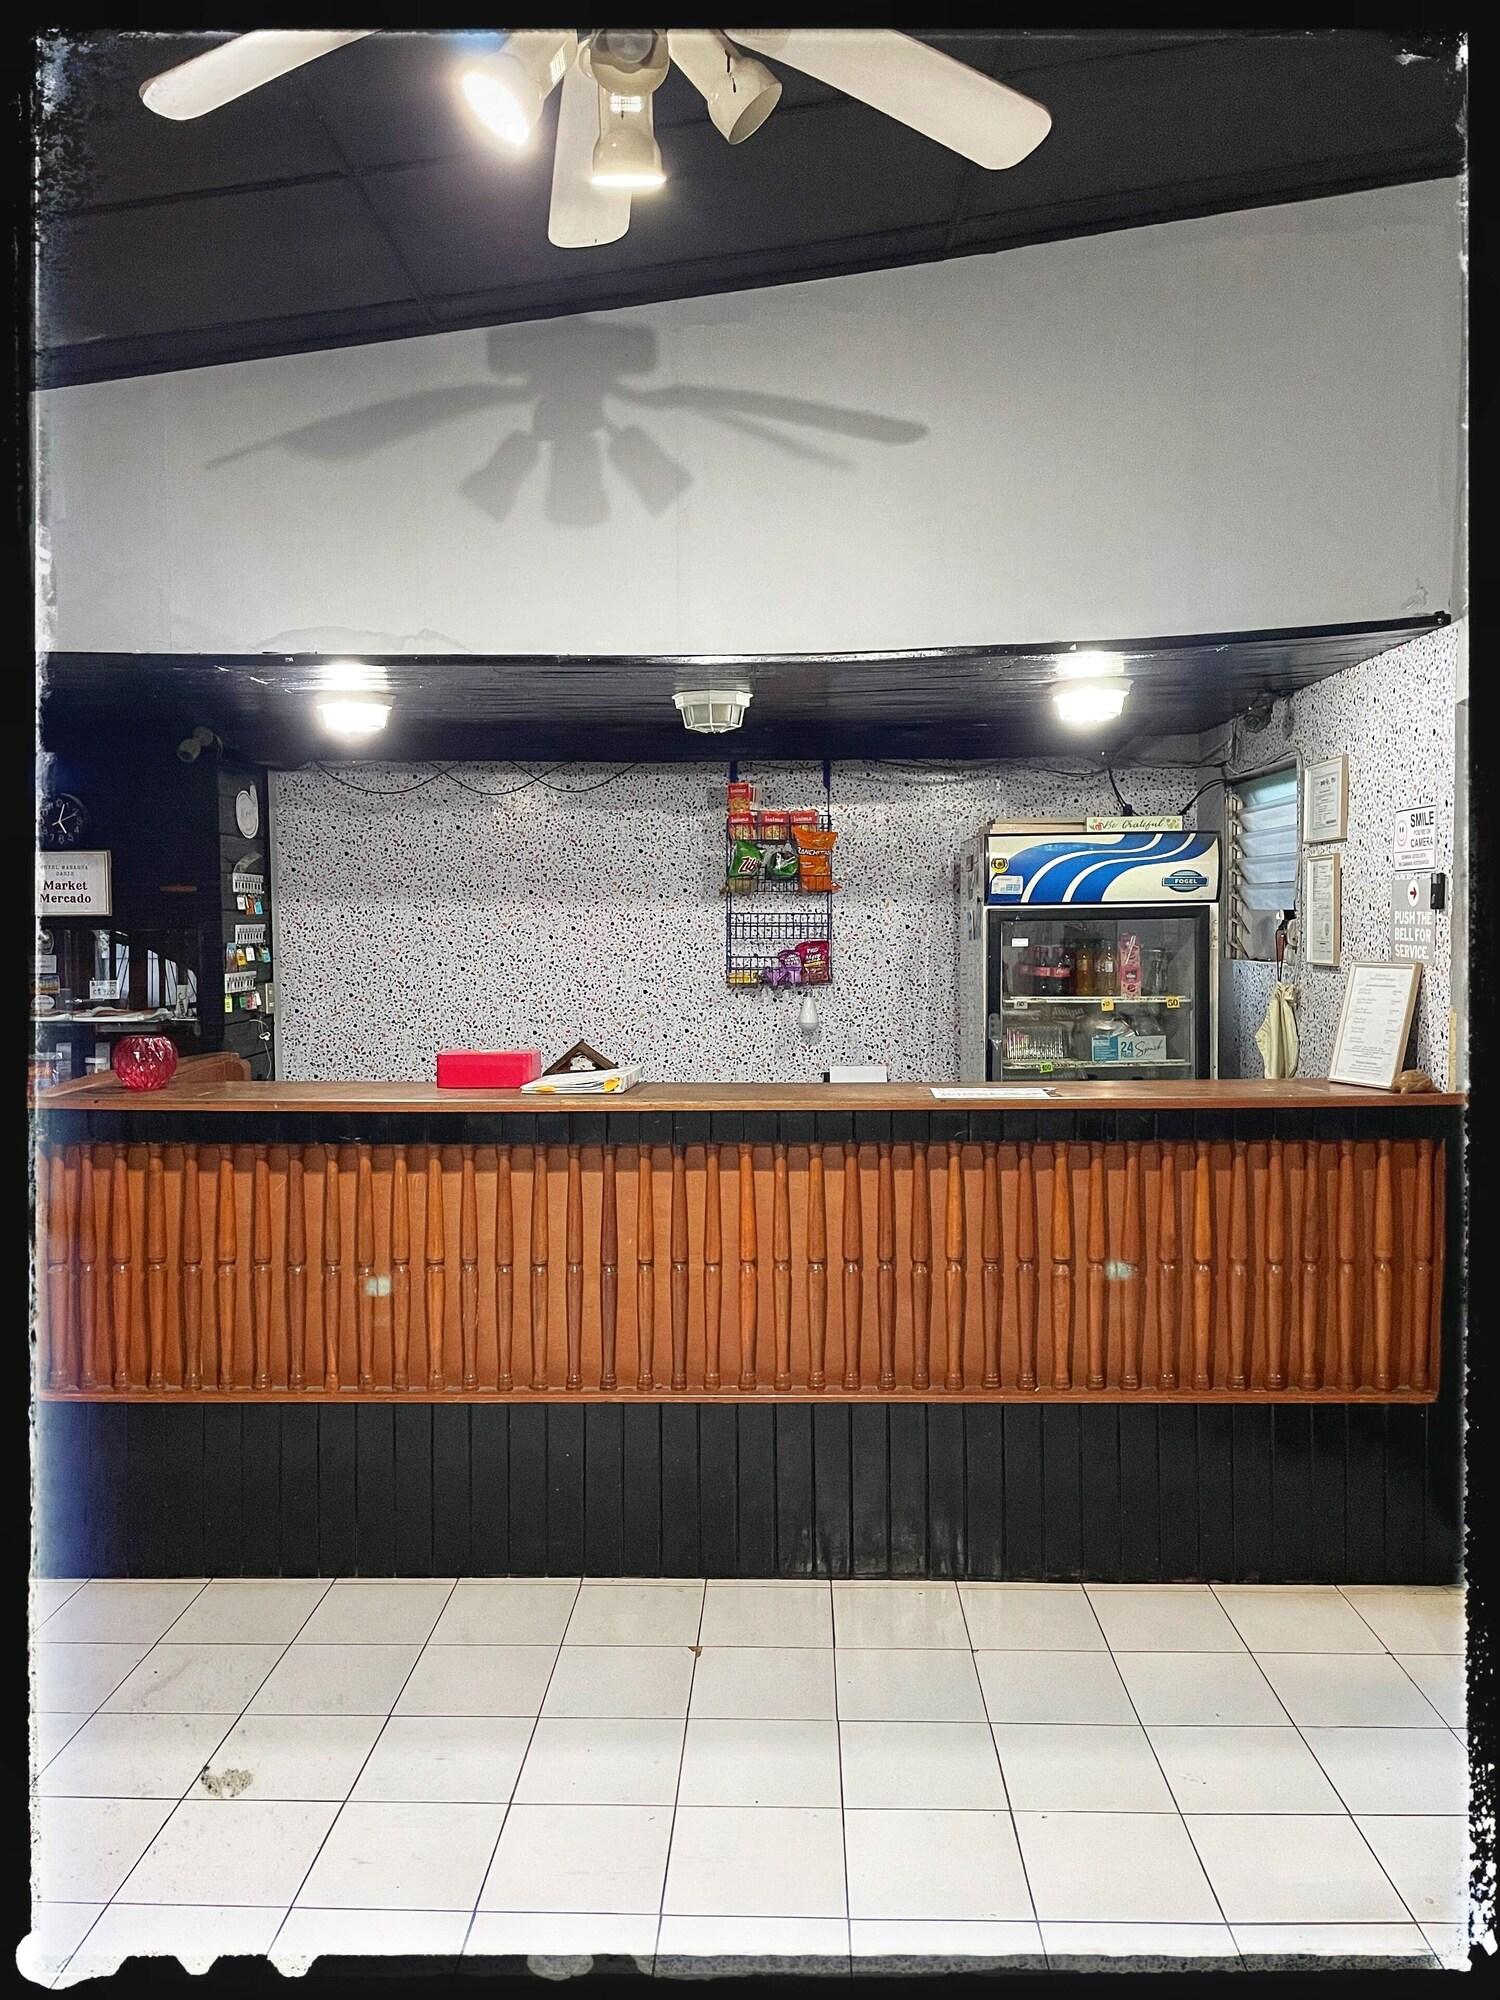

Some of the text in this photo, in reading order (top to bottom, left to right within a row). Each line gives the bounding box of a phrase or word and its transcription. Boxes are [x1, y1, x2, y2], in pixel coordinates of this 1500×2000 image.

[1411, 811, 1434, 827] SMILE
[1411, 837, 1433, 848] CAMERA
[43, 881, 88, 891] Market
[40, 894, 91, 904] Mercado
[1394, 910, 1432, 926] PUSH THE
[1394, 927, 1431, 943] BELL FOR
[1168, 999, 1178, 1007] 50
[1121, 1041, 1133, 1053] 24
